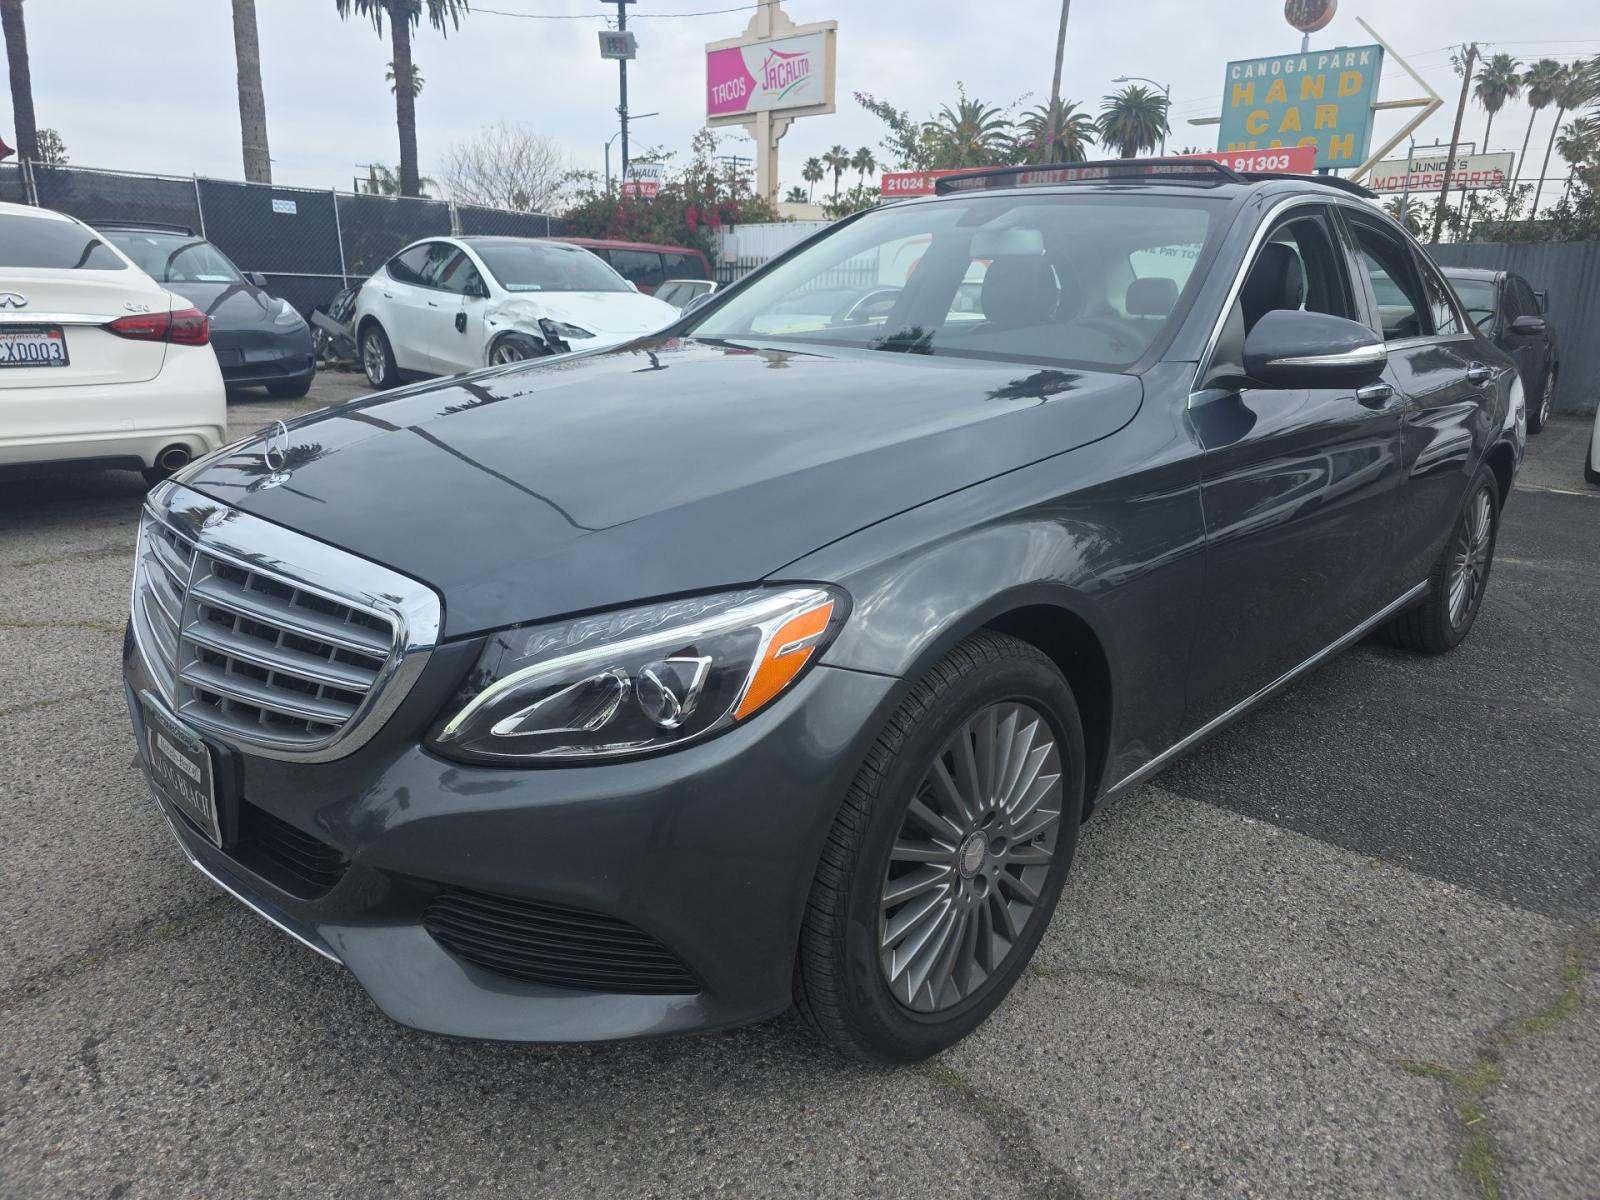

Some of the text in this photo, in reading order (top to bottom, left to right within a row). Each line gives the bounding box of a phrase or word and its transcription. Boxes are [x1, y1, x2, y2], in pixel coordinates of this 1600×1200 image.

[762, 57, 809, 91] JACALITO
[1232, 51, 1371, 80] CANOGA PARK
[712, 77, 746, 105] TACOS
[1231, 70, 1363, 108] HAND
[1246, 104, 1338, 136] CAR
[888, 179, 924, 190] 21024
[1234, 155, 1290, 173] 91303
